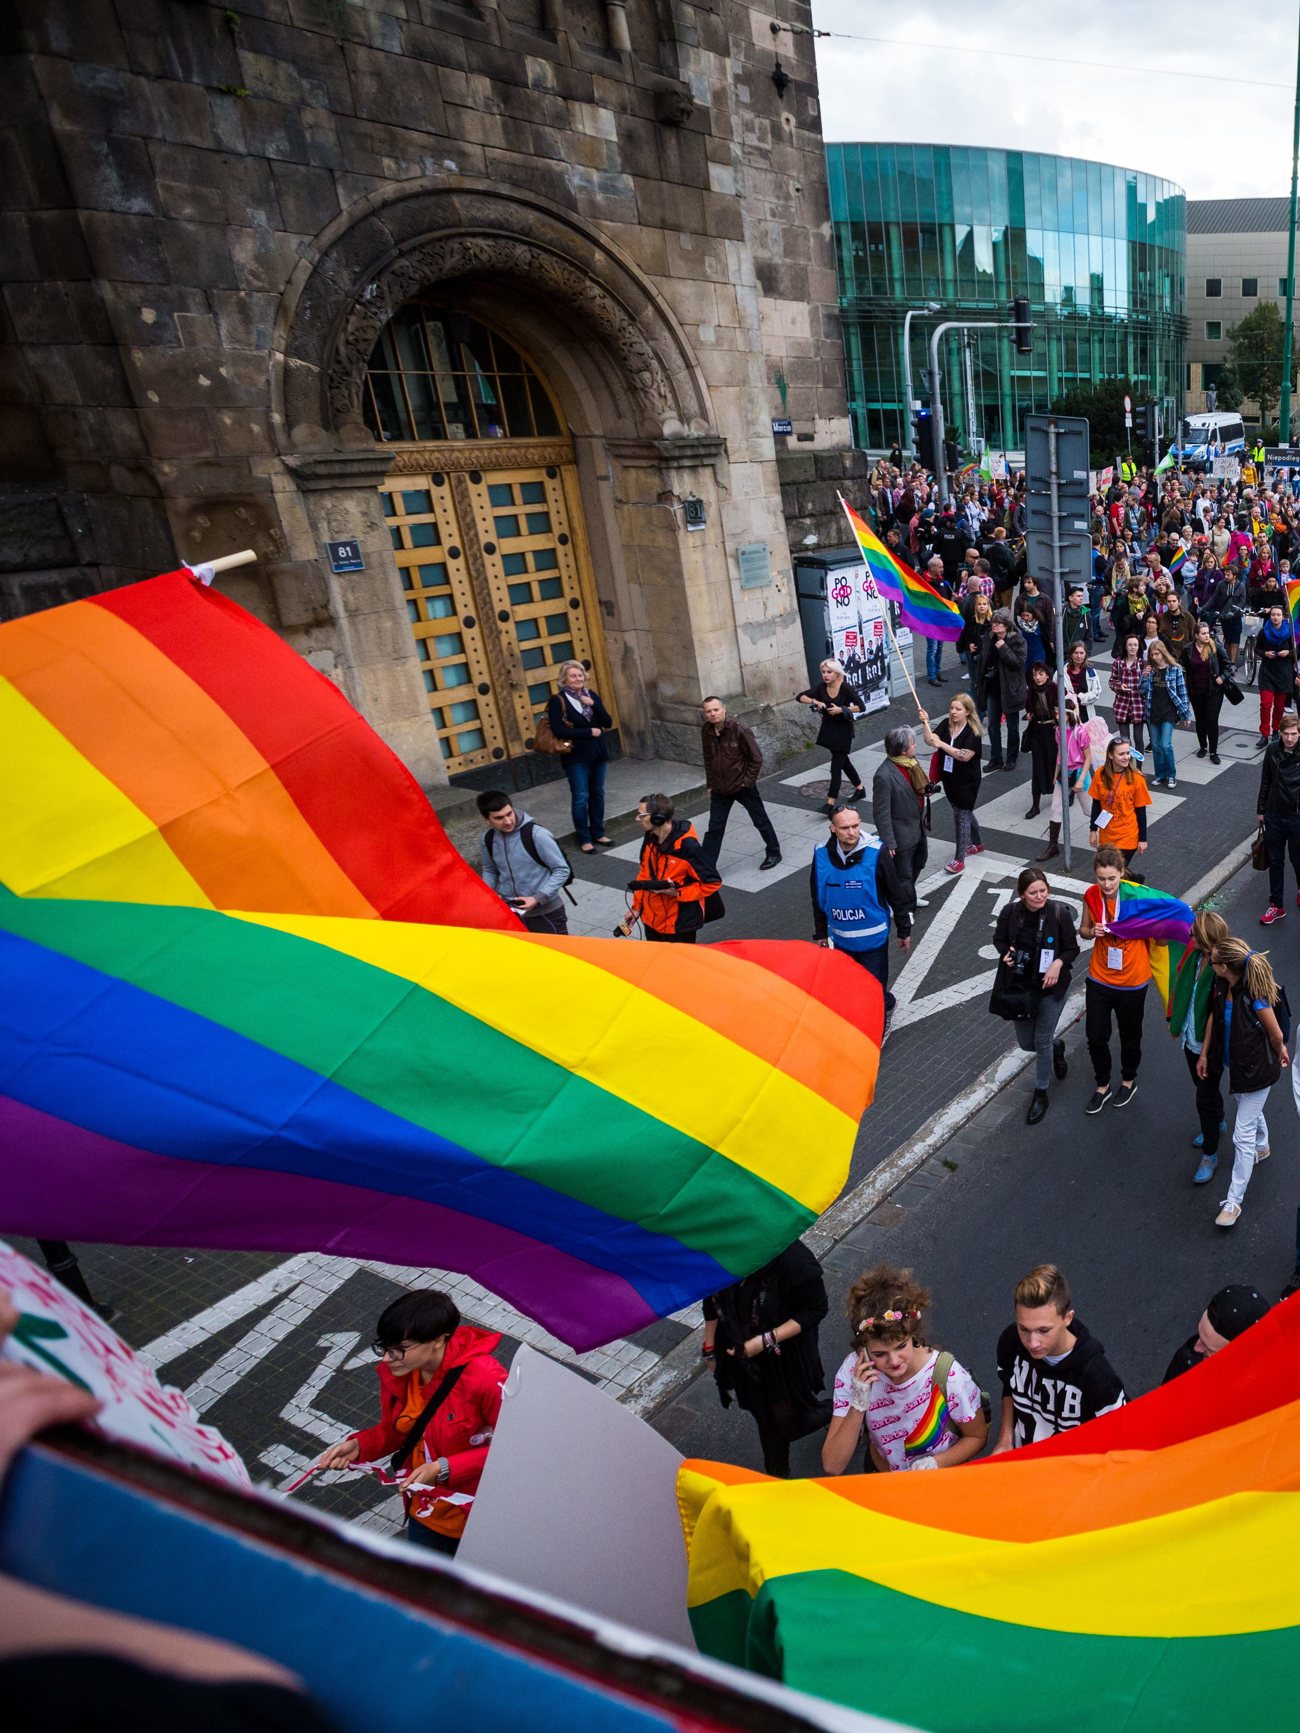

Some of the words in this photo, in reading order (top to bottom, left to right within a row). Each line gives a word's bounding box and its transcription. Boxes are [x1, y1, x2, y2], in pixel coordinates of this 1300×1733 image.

[338, 546, 352, 558] 81
[834, 576, 848, 589] PO
[836, 596, 850, 609] NO
[831, 908, 865, 921] POLICJA
